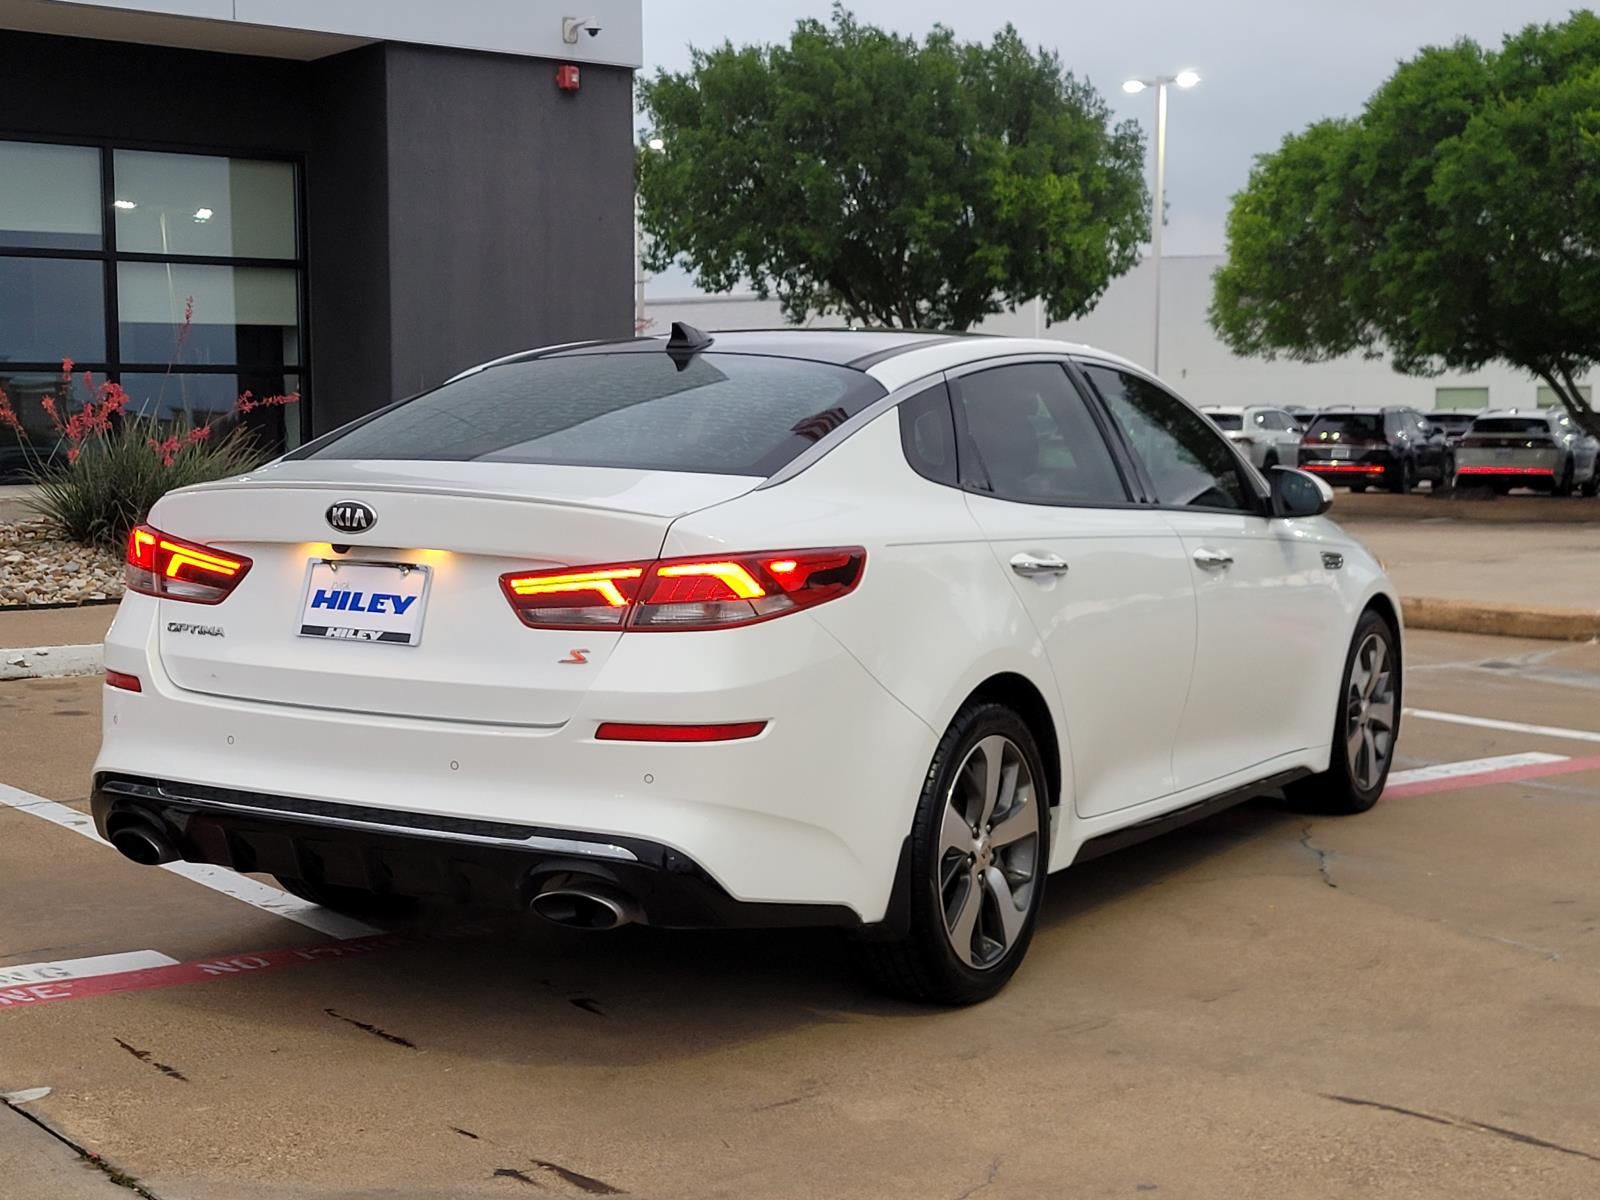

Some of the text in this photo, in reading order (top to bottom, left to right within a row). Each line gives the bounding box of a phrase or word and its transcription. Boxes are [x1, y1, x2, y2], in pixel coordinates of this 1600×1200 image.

[332, 507, 367, 527] KIA
[311, 589, 418, 615] HILEY
[167, 622, 225, 637] OPTIMA
[325, 627, 384, 641] HILEY
[196, 956, 271, 976] NO
